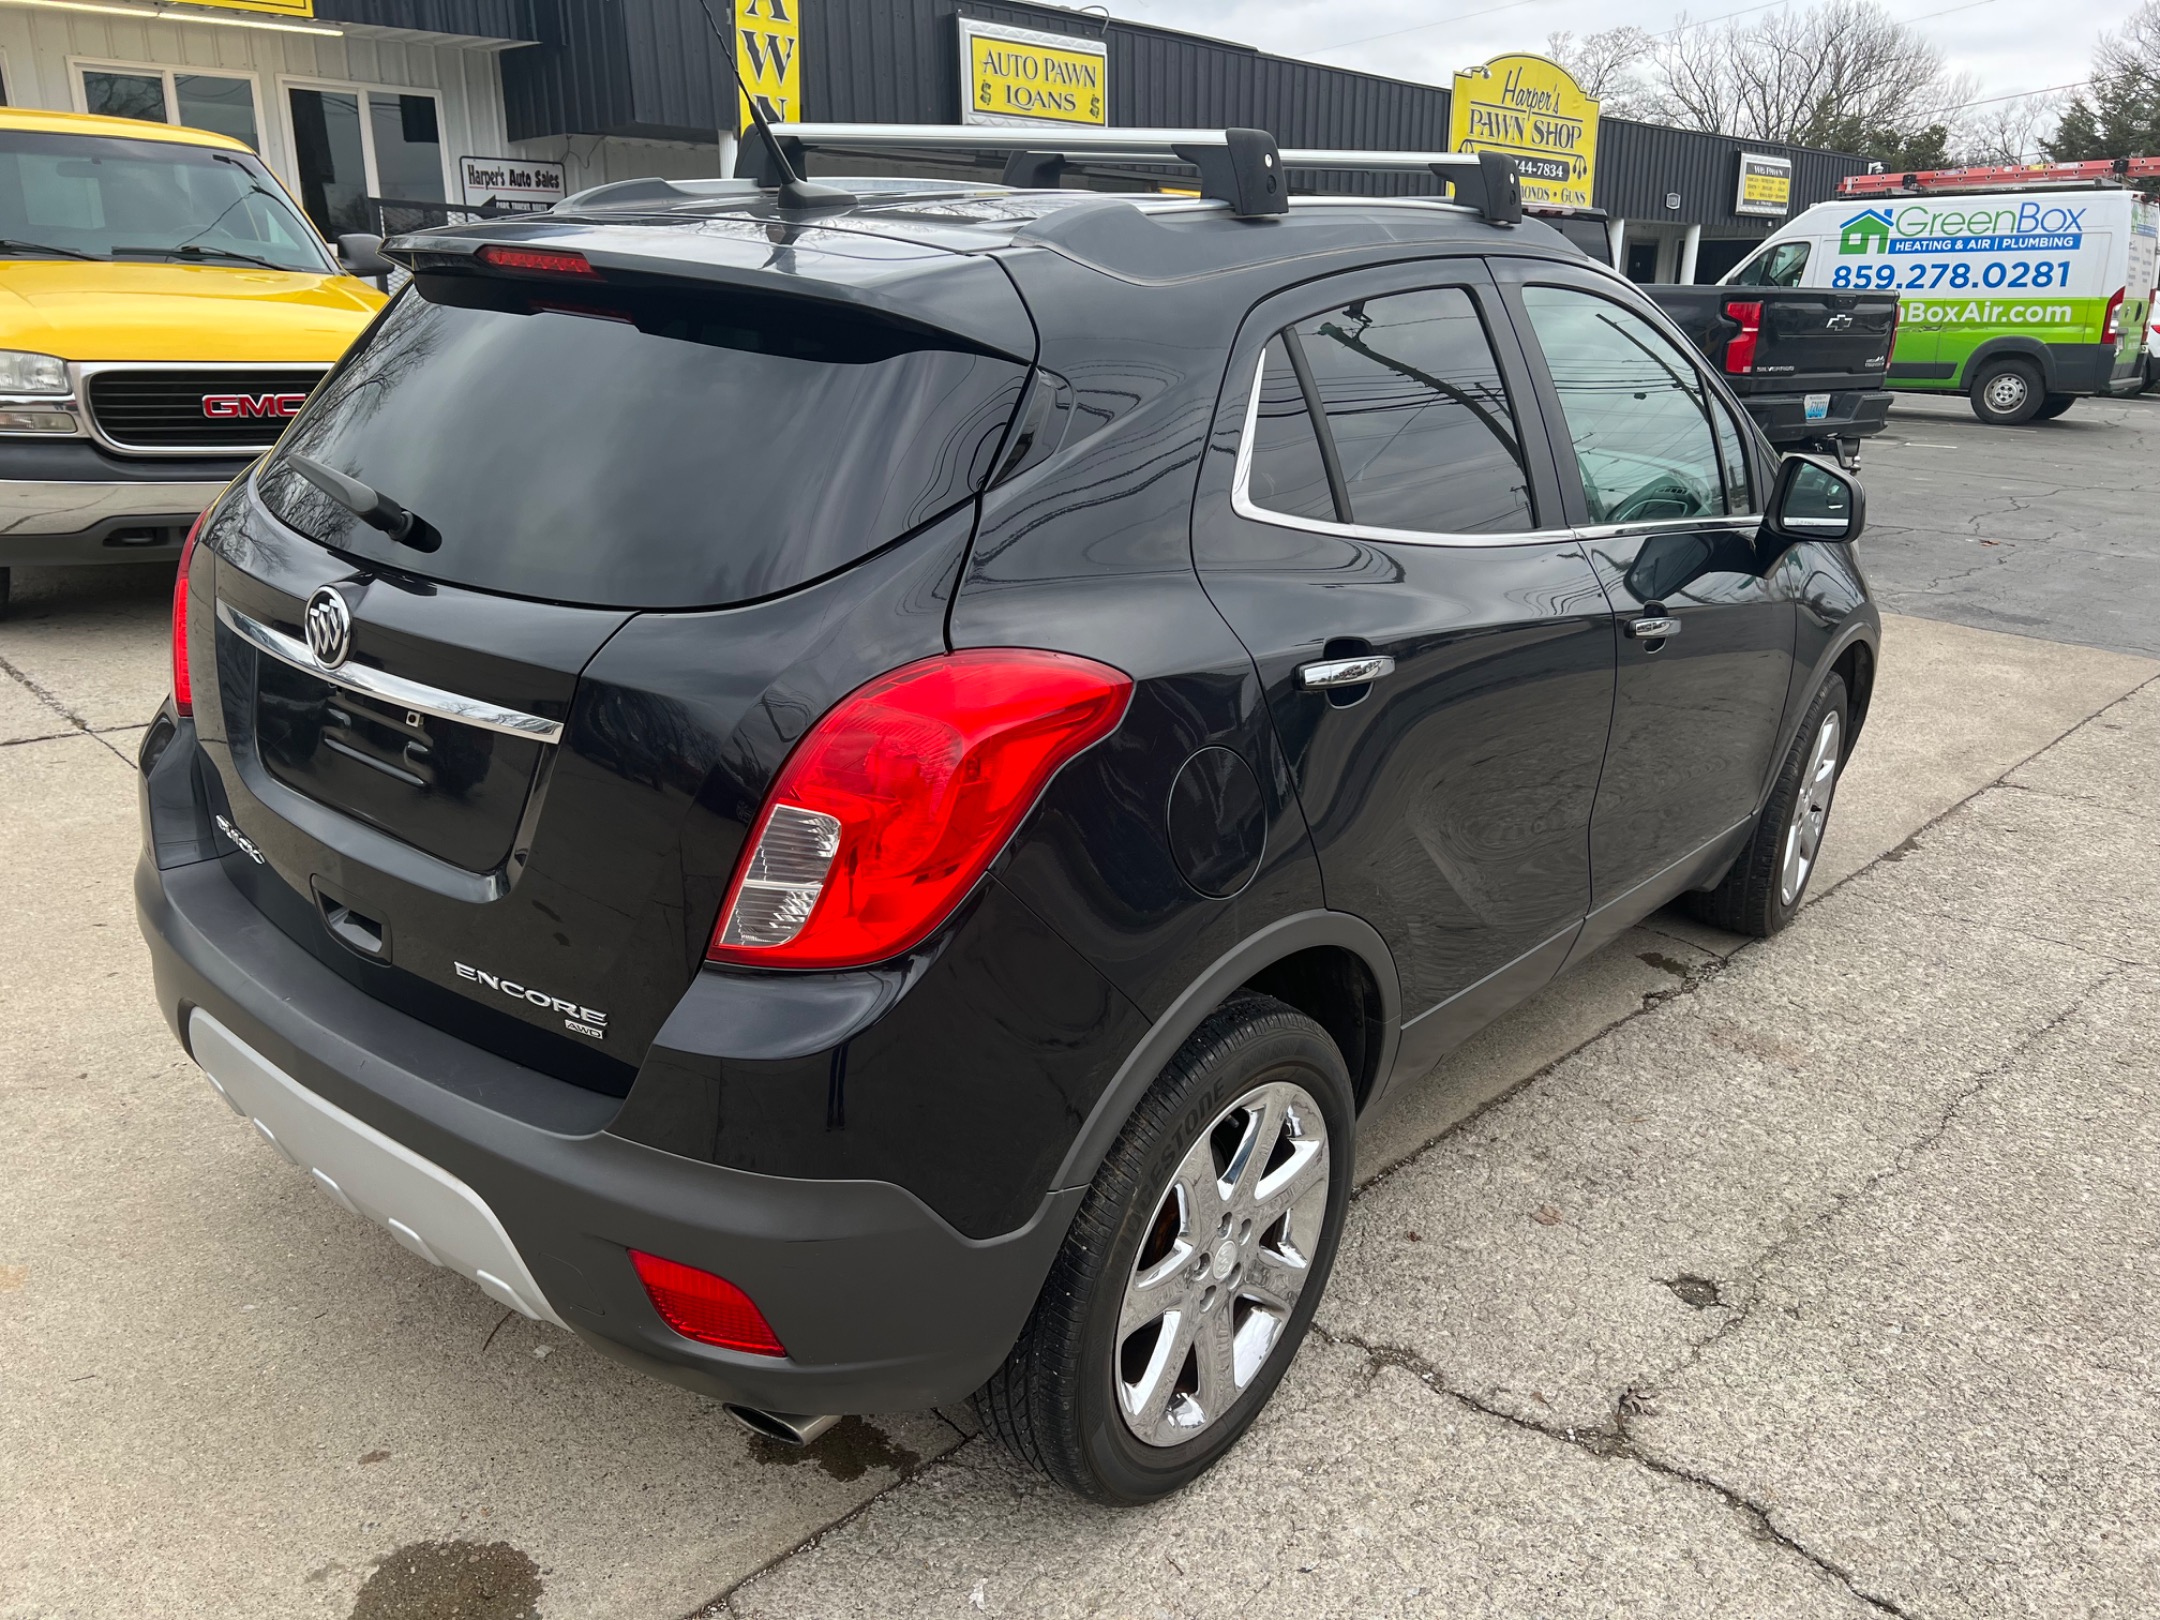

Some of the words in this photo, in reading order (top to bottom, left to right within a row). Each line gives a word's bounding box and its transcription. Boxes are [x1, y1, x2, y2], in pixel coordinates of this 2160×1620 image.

[983, 49, 1038, 80] AUTO
[1044, 58, 1096, 88] PAWN
[1006, 84, 1076, 111] LOANS
[1502, 66, 1560, 121] Harper's
[1469, 108, 1525, 143] PAWN
[1531, 119, 1582, 149] SHOP
[467, 164, 505, 190] Harper's
[509, 169, 531, 187] Auto
[535, 170, 560, 189] Sales
[1896, 202, 2088, 238] GreenBox
[1895, 238, 1952, 252] HEATING
[1954, 239, 1963, 250] &
[1967, 238, 1990, 250] AIR
[2002, 236, 2074, 250] PLUMBING
[1831, 261, 2071, 290] 859.278.0281
[202, 393, 306, 418] GMC
[453, 960, 609, 1027] ENCORE
[567, 1021, 602, 1038] AWD
